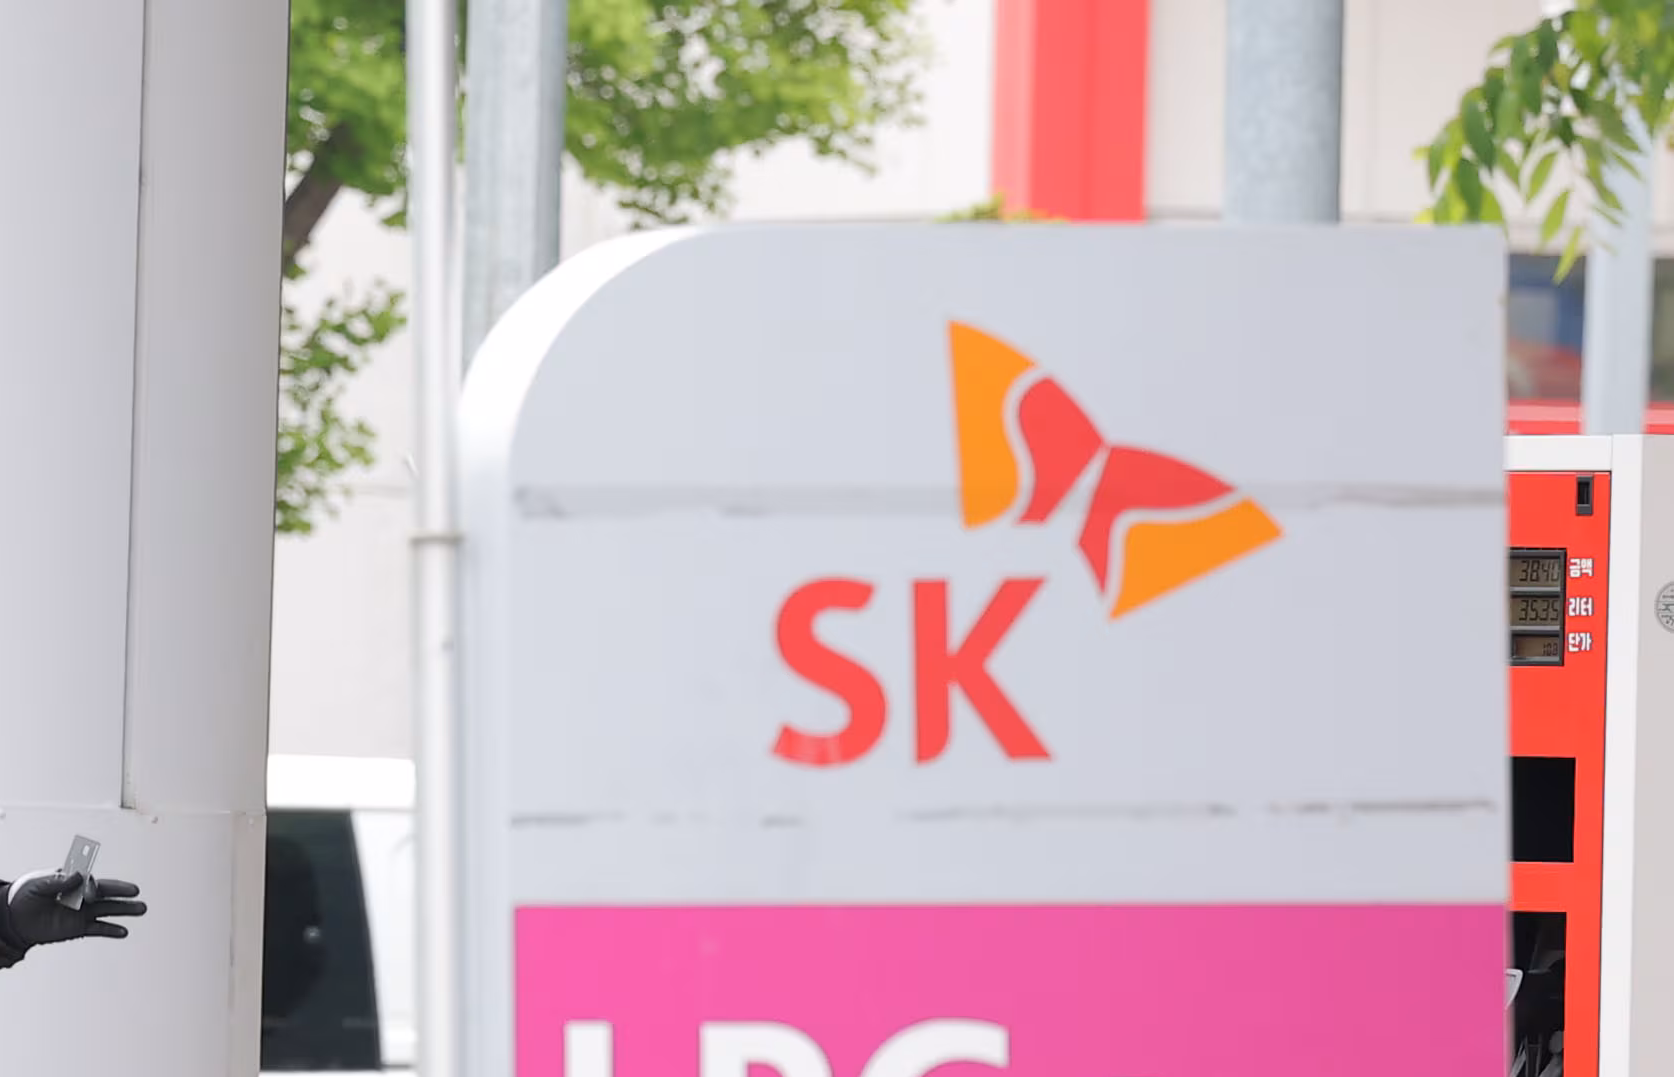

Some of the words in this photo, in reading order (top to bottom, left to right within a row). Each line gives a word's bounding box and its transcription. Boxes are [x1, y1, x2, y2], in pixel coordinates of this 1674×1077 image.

[1569, 558, 1593, 578] 금액
[1568, 597, 1592, 616] 리터
[1568, 632, 1592, 652] 단가
[771, 577, 1054, 767] SK
